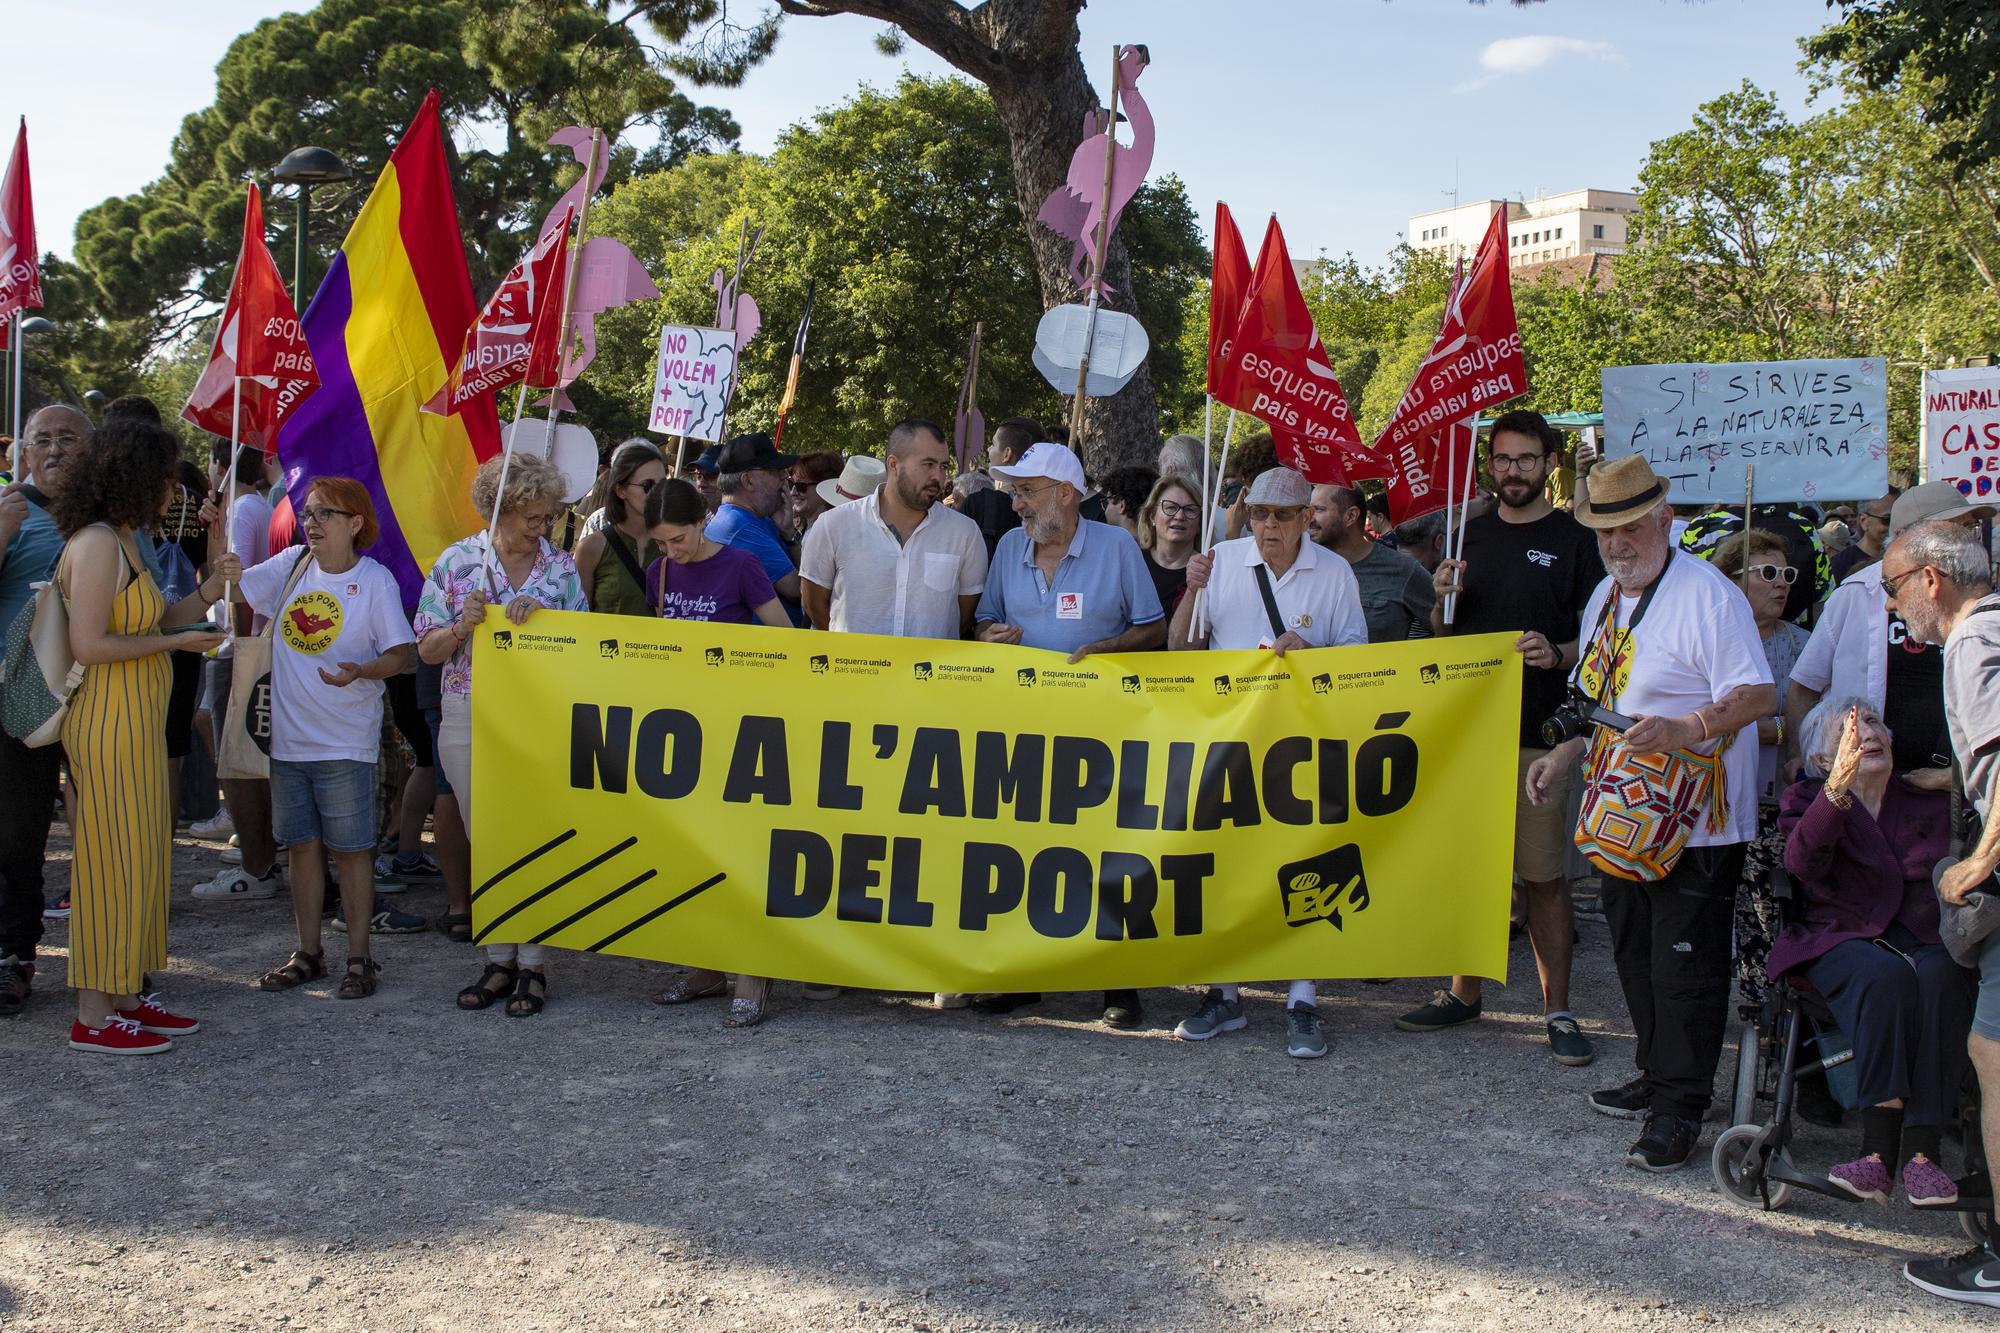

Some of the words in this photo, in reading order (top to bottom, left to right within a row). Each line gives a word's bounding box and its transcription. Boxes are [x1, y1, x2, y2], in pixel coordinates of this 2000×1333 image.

[667, 334, 687, 355] NO
[273, 350, 313, 372] país
[663, 358, 716, 385] VOLEM
[1241, 352, 1350, 422] esquerra
[1928, 388, 2000, 412] NATURAL
[655, 406, 693, 430] PORT
[1252, 393, 1300, 426] país
[1676, 416, 1709, 437] LA
[1970, 456, 1999, 474] DE
[294, 594, 314, 606] MÉS
[316, 594, 340, 620] PORT?
[283, 620, 292, 637] NO
[291, 634, 332, 652] GRÀCIES
[519, 634, 552, 642] esquerra
[553, 636, 576, 644] unida
[625, 642, 658, 651] esquerra
[659, 644, 682, 652] unida
[730, 650, 762, 659] esquerra
[764, 652, 787, 660] unida
[835, 657, 868, 667] esquerra
[868, 659, 892, 667] unida
[938, 664, 970, 673] esquerra
[972, 666, 994, 674] unida
[1446, 662, 1479, 670] esquerra
[1480, 659, 1502, 667] unida
[1042, 669, 1074, 680] esquerra
[1076, 672, 1098, 680] unida
[1146, 676, 1173, 685] esquerra
[1236, 675, 1266, 685] esquerra
[1268, 672, 1290, 680] unida
[1338, 672, 1371, 682] esquerra
[1373, 668, 1396, 676] unida
[570, 703, 703, 800] NO
[722, 715, 792, 806] A
[766, 828, 934, 928] DEL
[959, 841, 1215, 942] PORT
